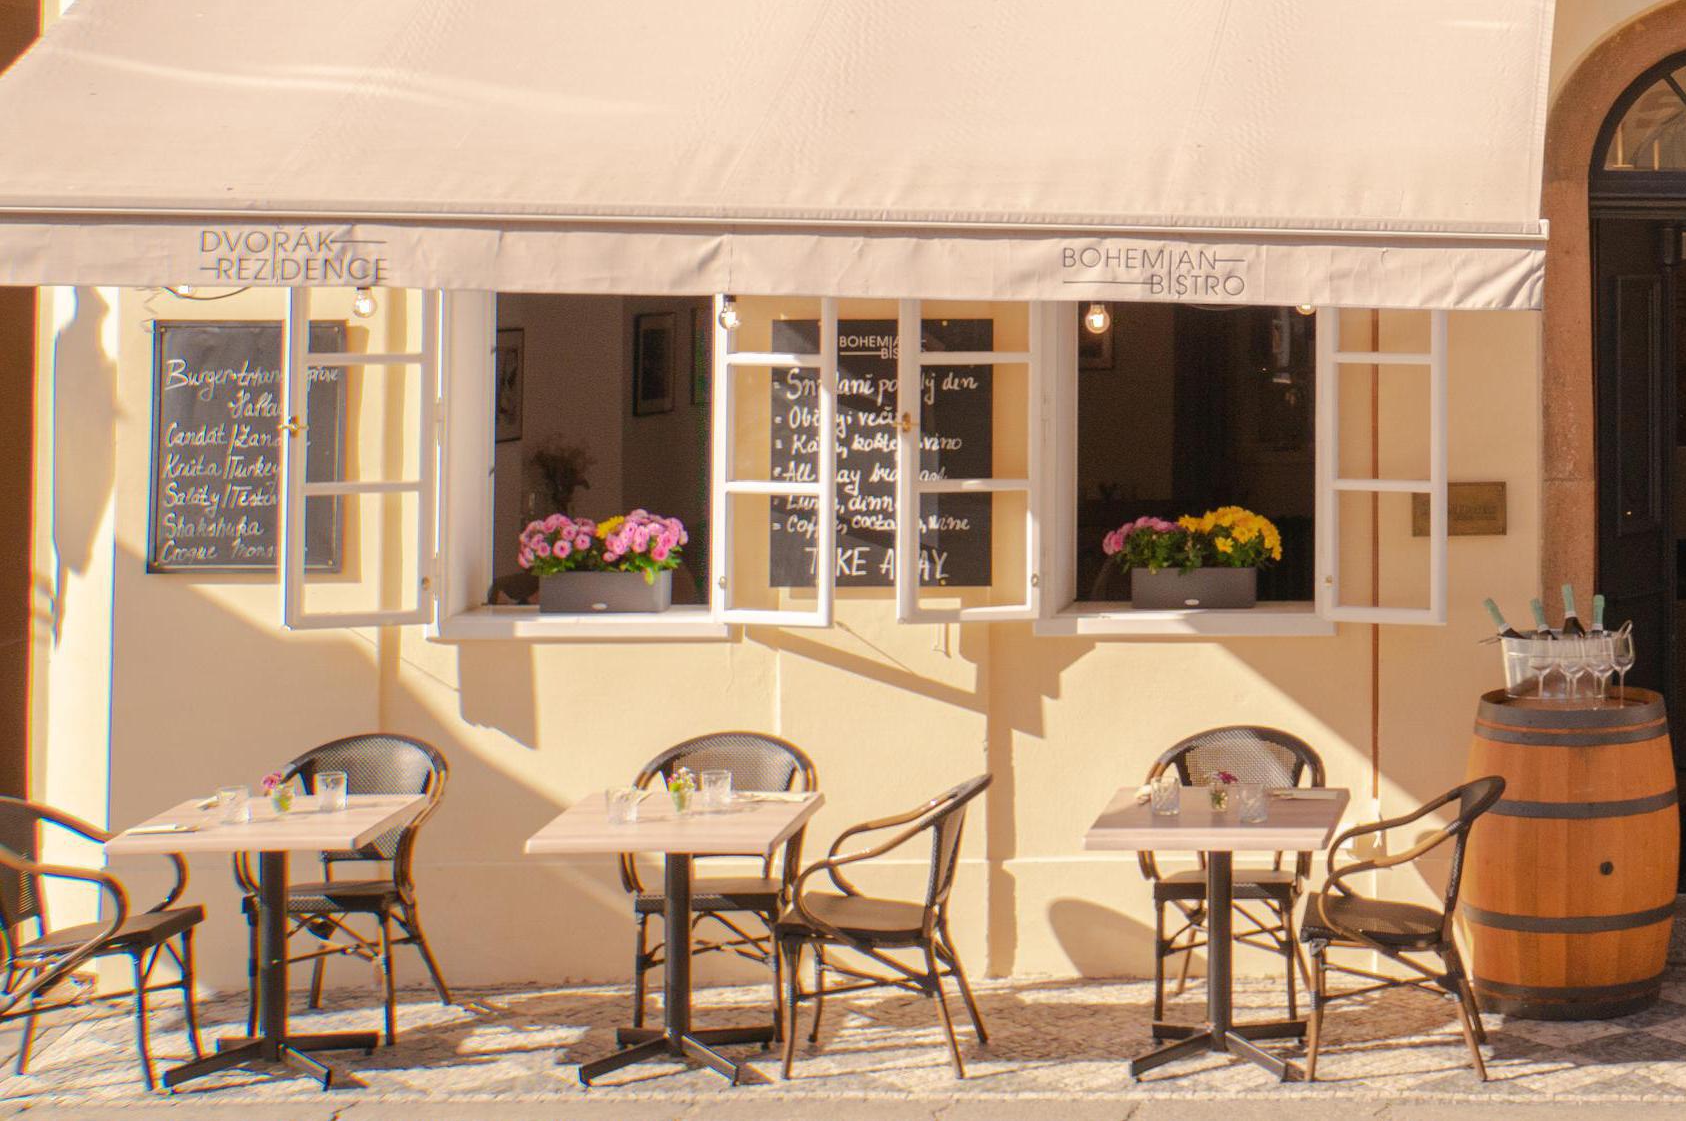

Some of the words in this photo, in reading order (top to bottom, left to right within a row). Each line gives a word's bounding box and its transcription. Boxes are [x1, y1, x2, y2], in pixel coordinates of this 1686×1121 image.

[217, 257, 388, 280] REZIDENCE
[1062, 247, 1217, 270] BOHEMIAN
[1150, 274, 1245, 296] BISTRO
[942, 372, 979, 390] den
[803, 547, 871, 577] TKE
[879, 548, 949, 580] AAY
